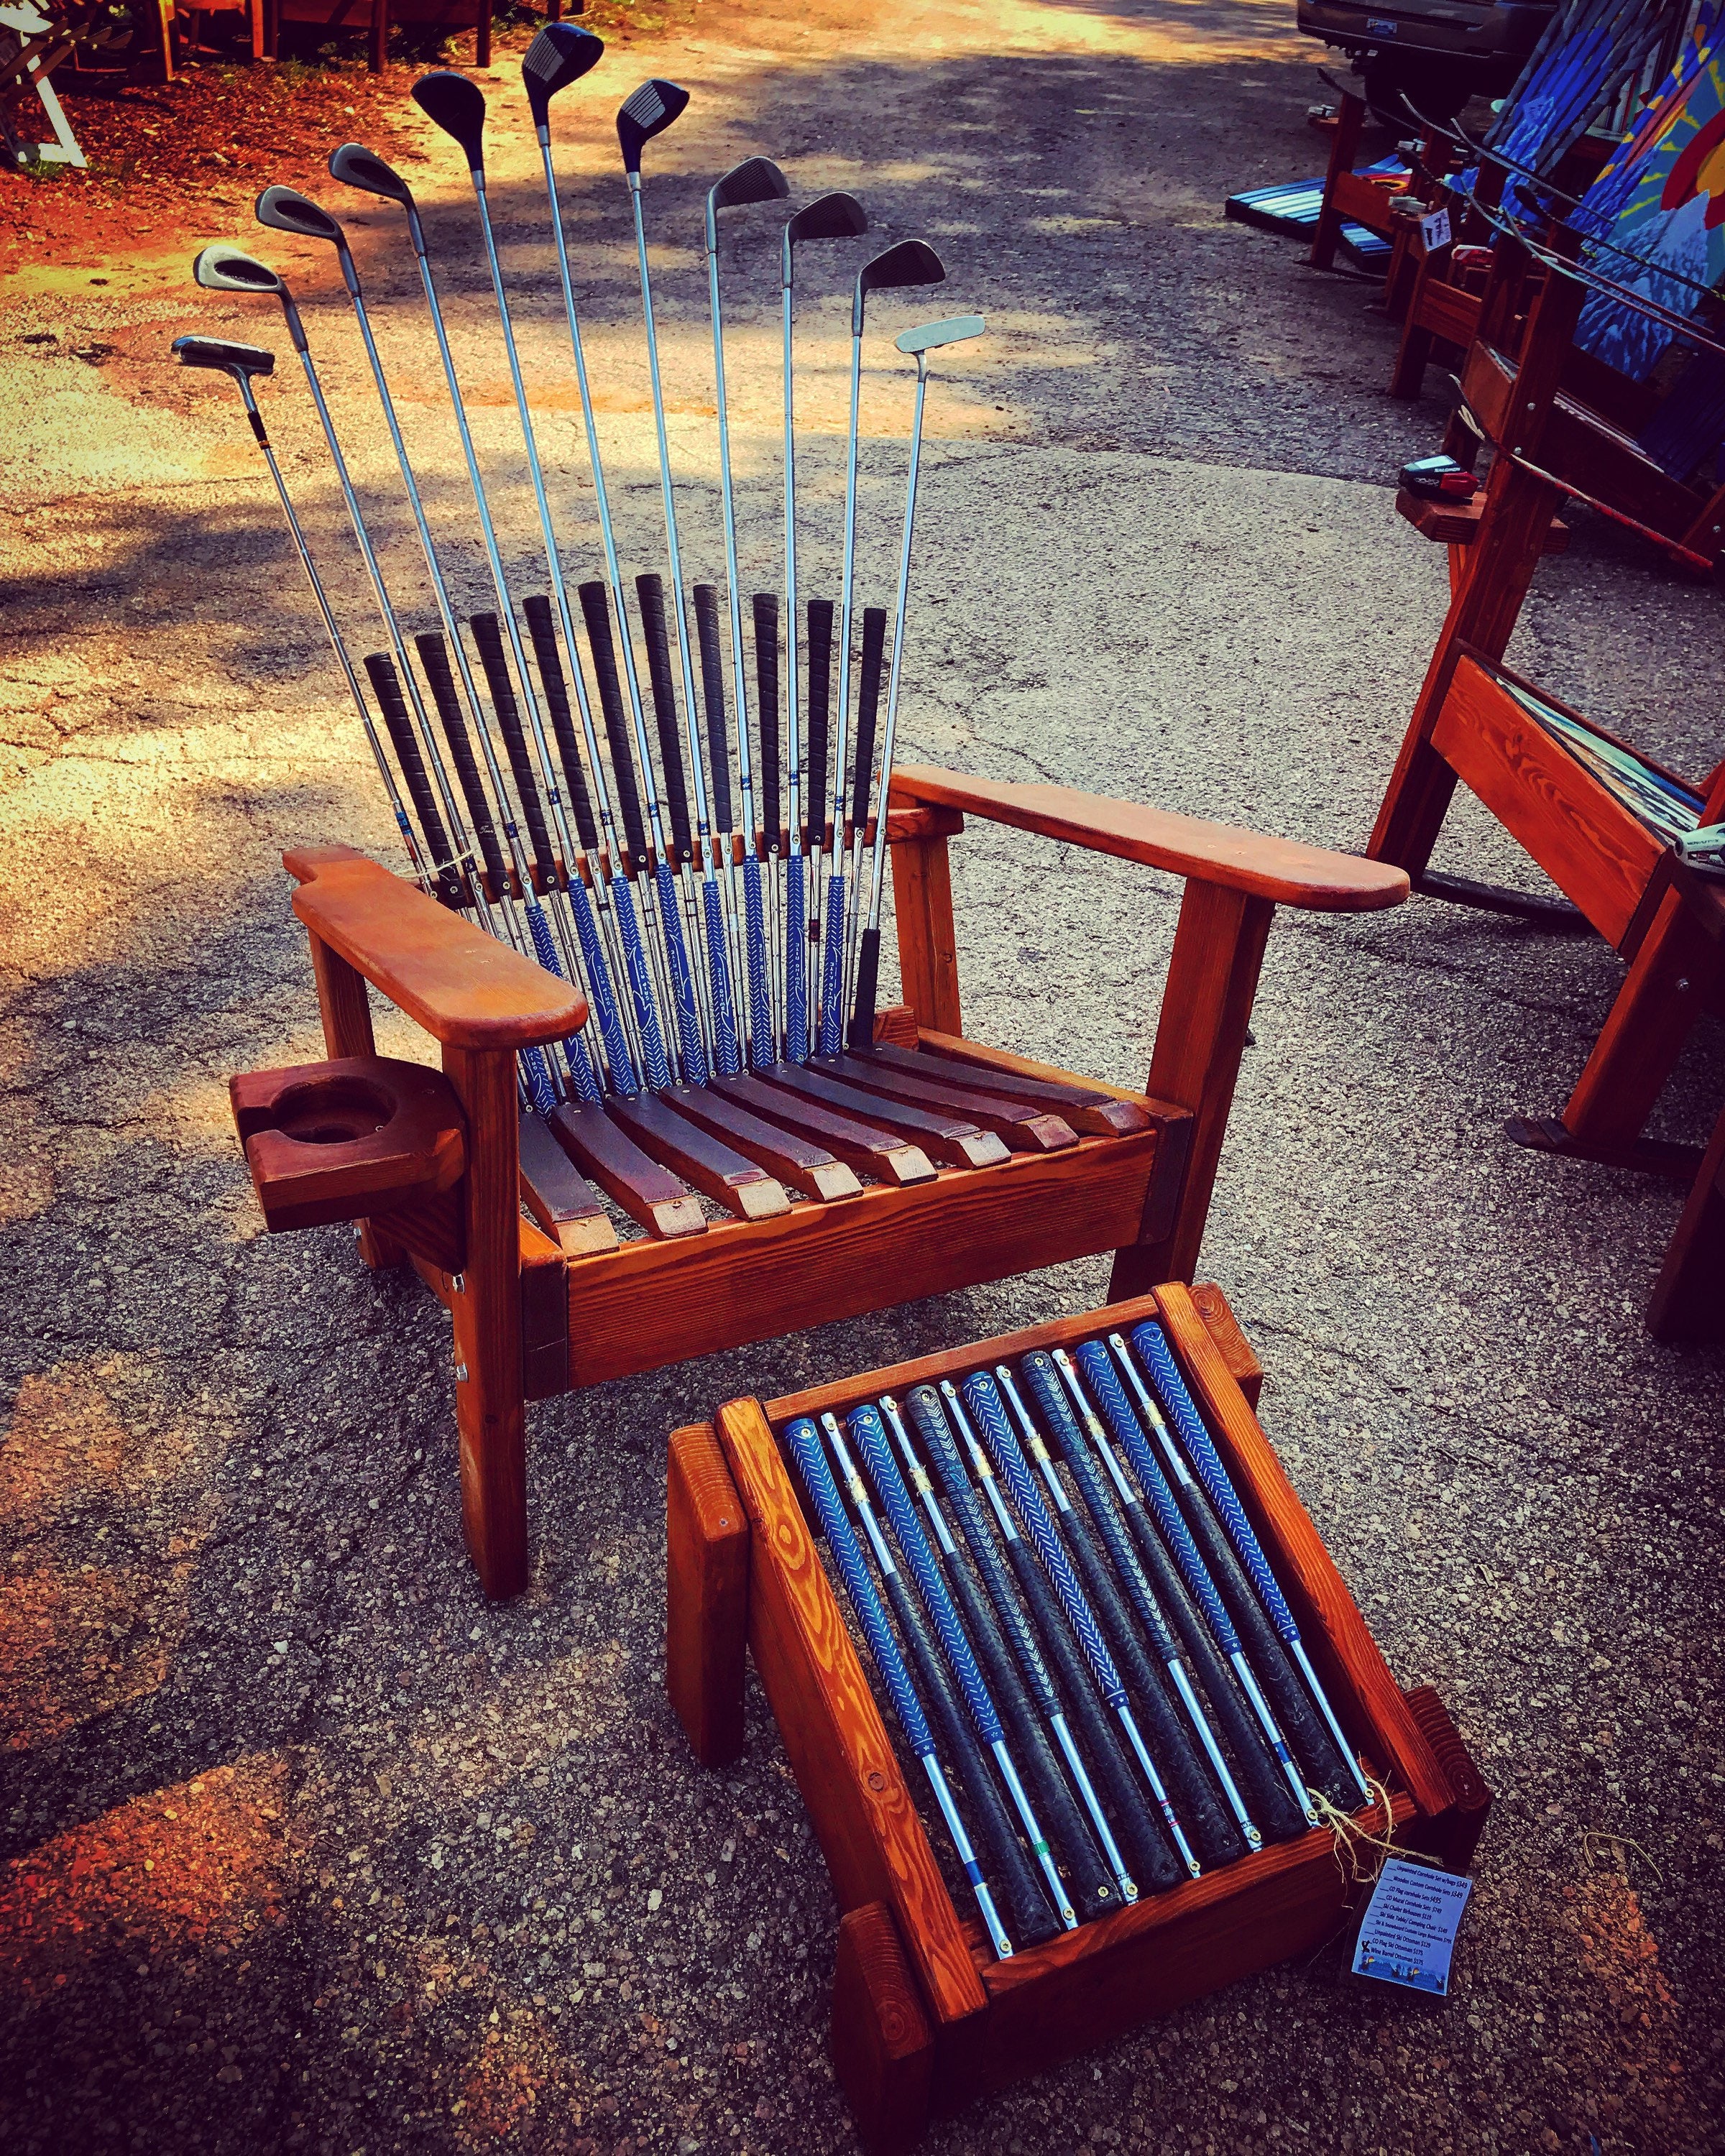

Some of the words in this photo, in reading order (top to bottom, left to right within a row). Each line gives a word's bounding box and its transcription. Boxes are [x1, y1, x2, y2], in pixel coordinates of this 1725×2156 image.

[1396, 1865, 1417, 1874] Unpainted
[1417, 1870, 1435, 1879] Cornhole
[1409, 1879, 1424, 1888] Custom
[1424, 1884, 1442, 1893] Cornhole
[1404, 1899, 1422, 1909] Cornhole
[1408, 1919, 1426, 1929] Camping
[1373, 1928, 1396, 1939] Unpainted
[1402, 1935, 1420, 1945] Ottoman
[1379, 1939, 1387, 1948] Flag
[1394, 1943, 1412, 1953] Ottoman
[1394, 1953, 1413, 1963] Ottoman
